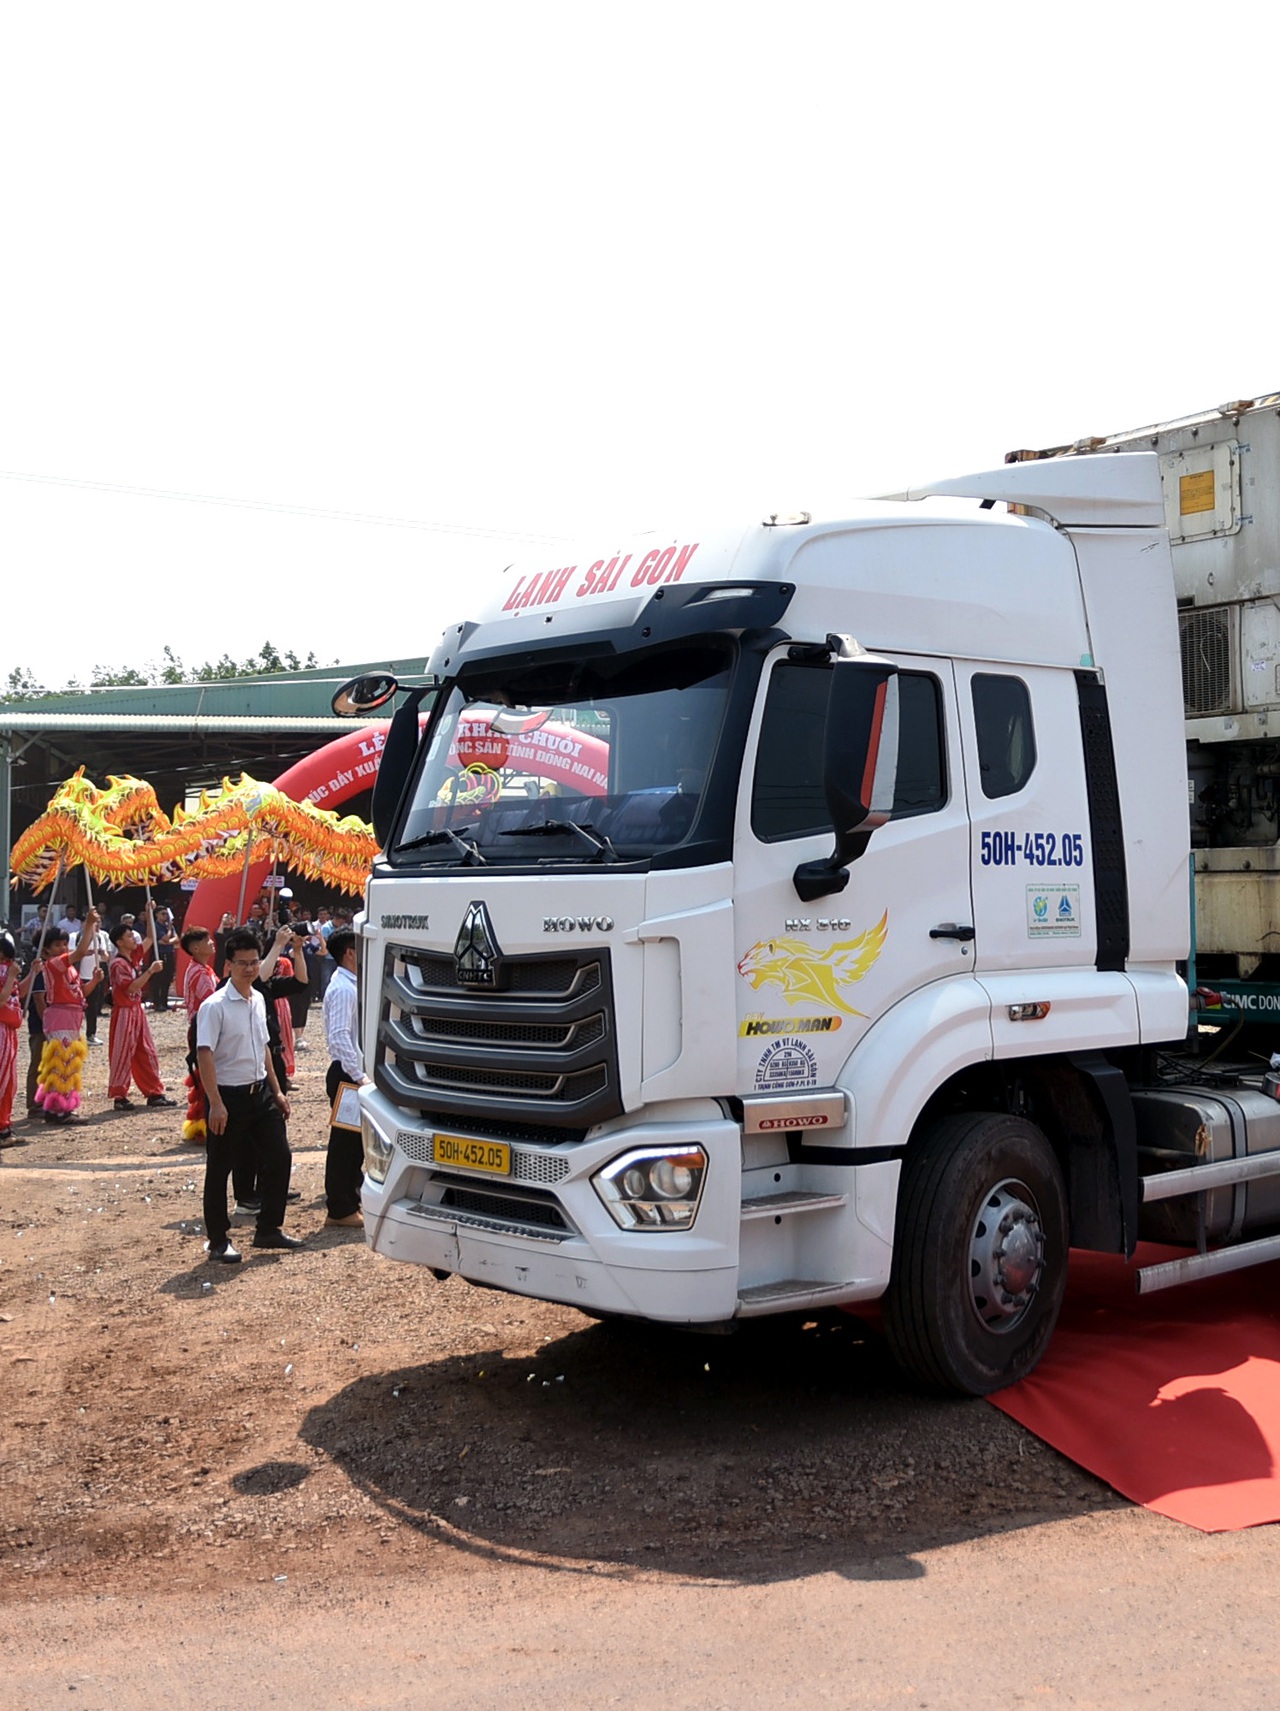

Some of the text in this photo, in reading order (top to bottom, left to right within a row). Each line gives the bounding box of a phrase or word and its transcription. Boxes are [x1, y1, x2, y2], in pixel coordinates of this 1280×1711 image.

[501, 565, 578, 617] LẠNH
[358, 731, 385, 757] LỄ
[328, 770, 354, 792] ĐẨY
[355, 754, 382, 777] XUẤ
[571, 761, 595, 780] NAI
[981, 831, 1083, 867] 50H-452.05
[381, 915, 429, 930] SINOTRUK
[542, 915, 615, 933] HOWO
[796, 1017, 832, 1033] MAN
[773, 1116, 823, 1128] HOWO
[439, 1140, 502, 1167] 50H-452.05
